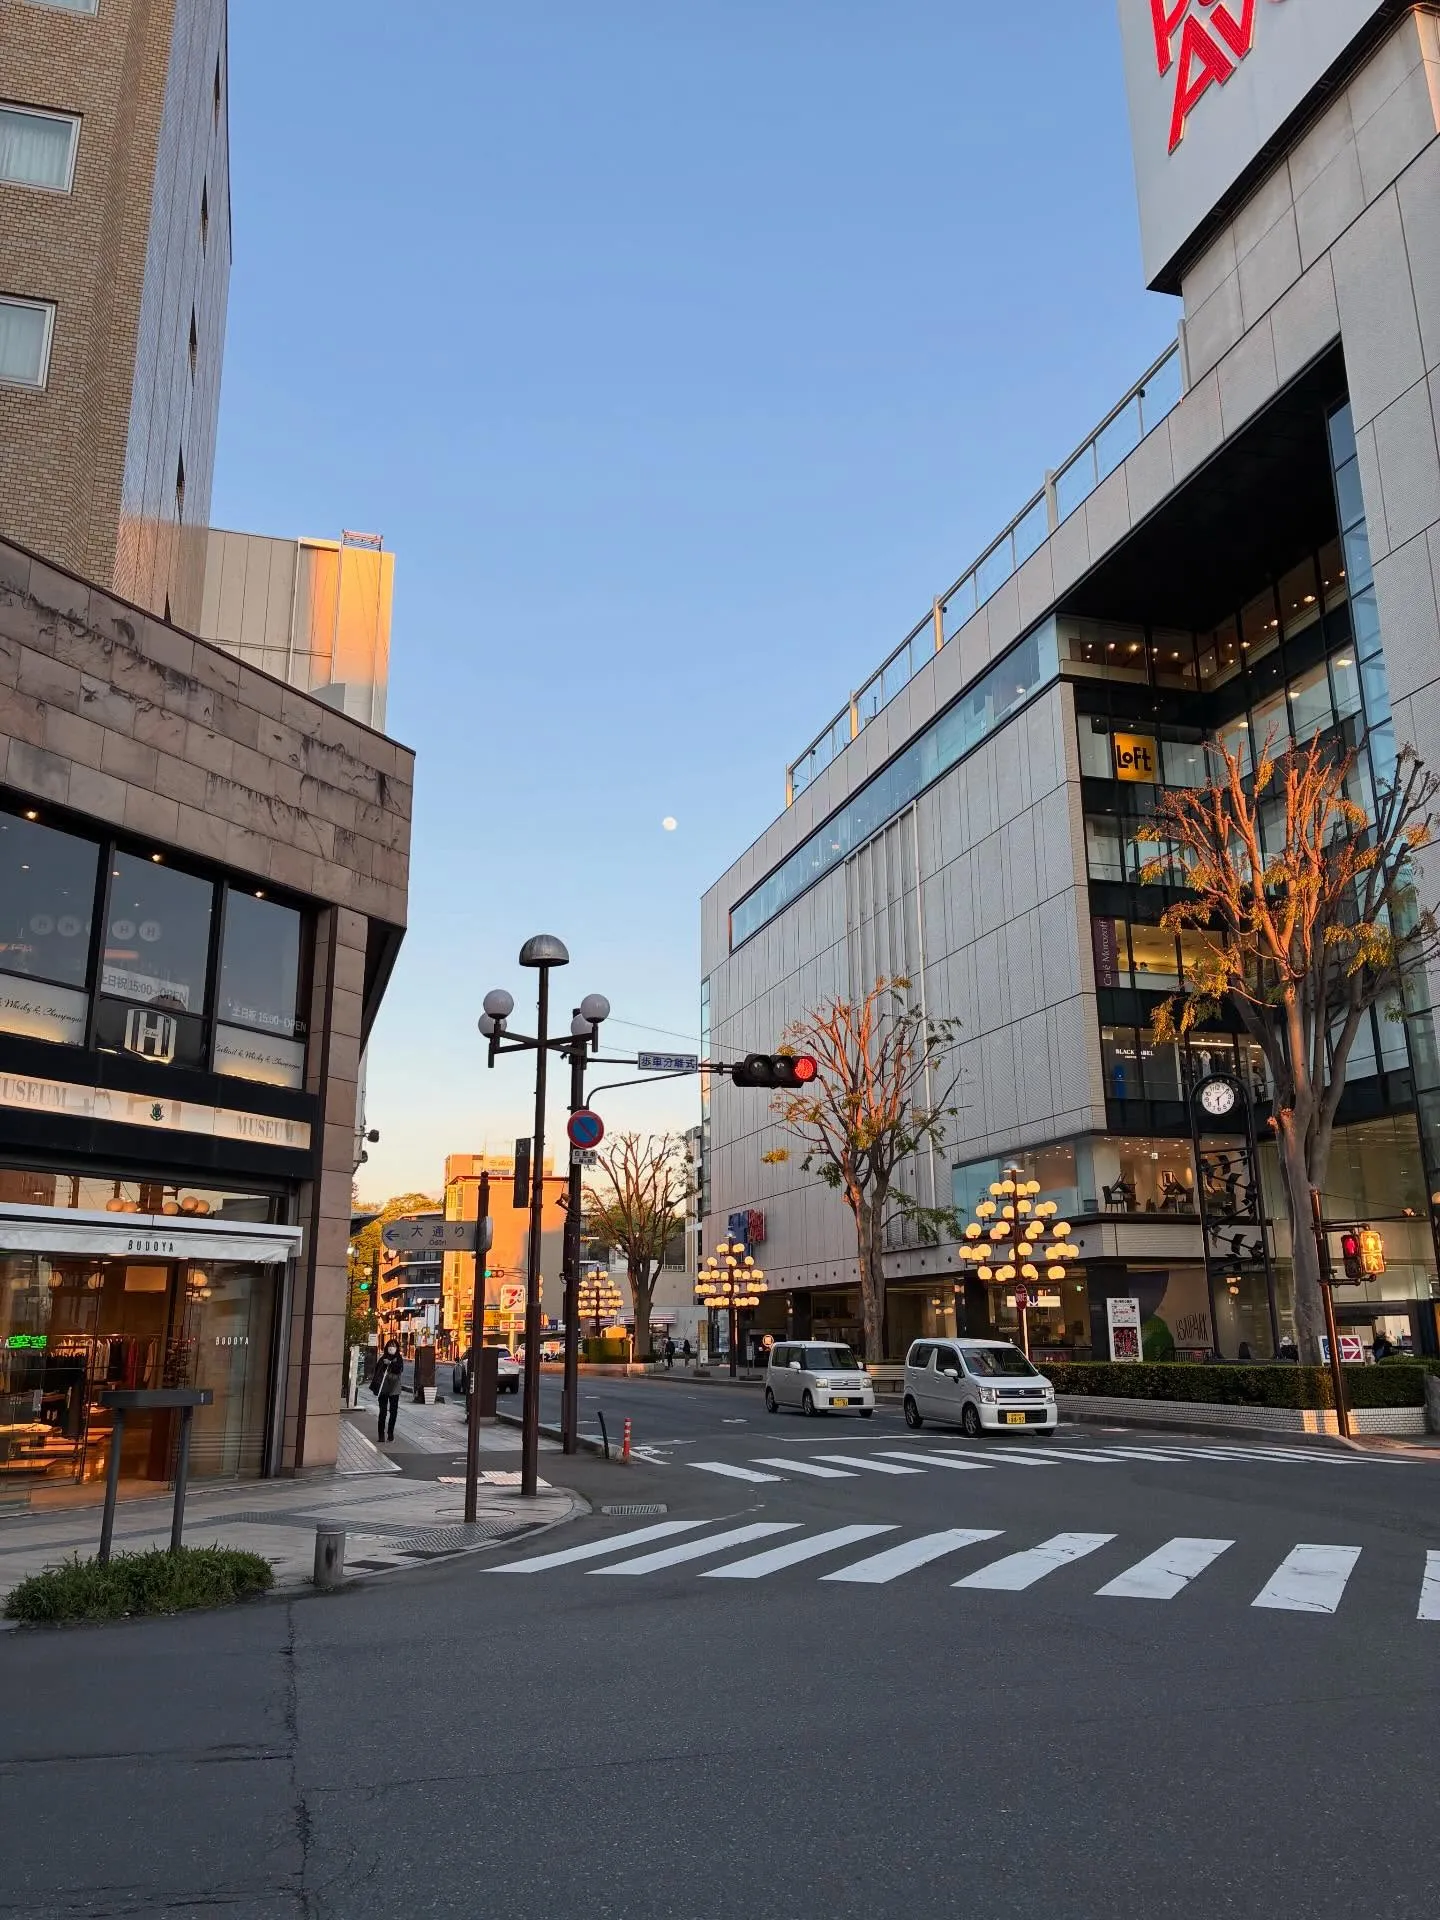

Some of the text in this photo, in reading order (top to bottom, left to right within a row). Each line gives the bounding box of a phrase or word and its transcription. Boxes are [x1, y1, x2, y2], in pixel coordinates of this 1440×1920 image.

[1098, 919, 1111, 962] Morozoff
[283, 1017, 307, 1033] OPEN
[641, 1056, 696, 1069] 歩車分離式
[237, 1115, 294, 1142] MUSEUM
[411, 1225, 465, 1237] 大通り
[128, 1239, 174, 1253] BUDOYA
